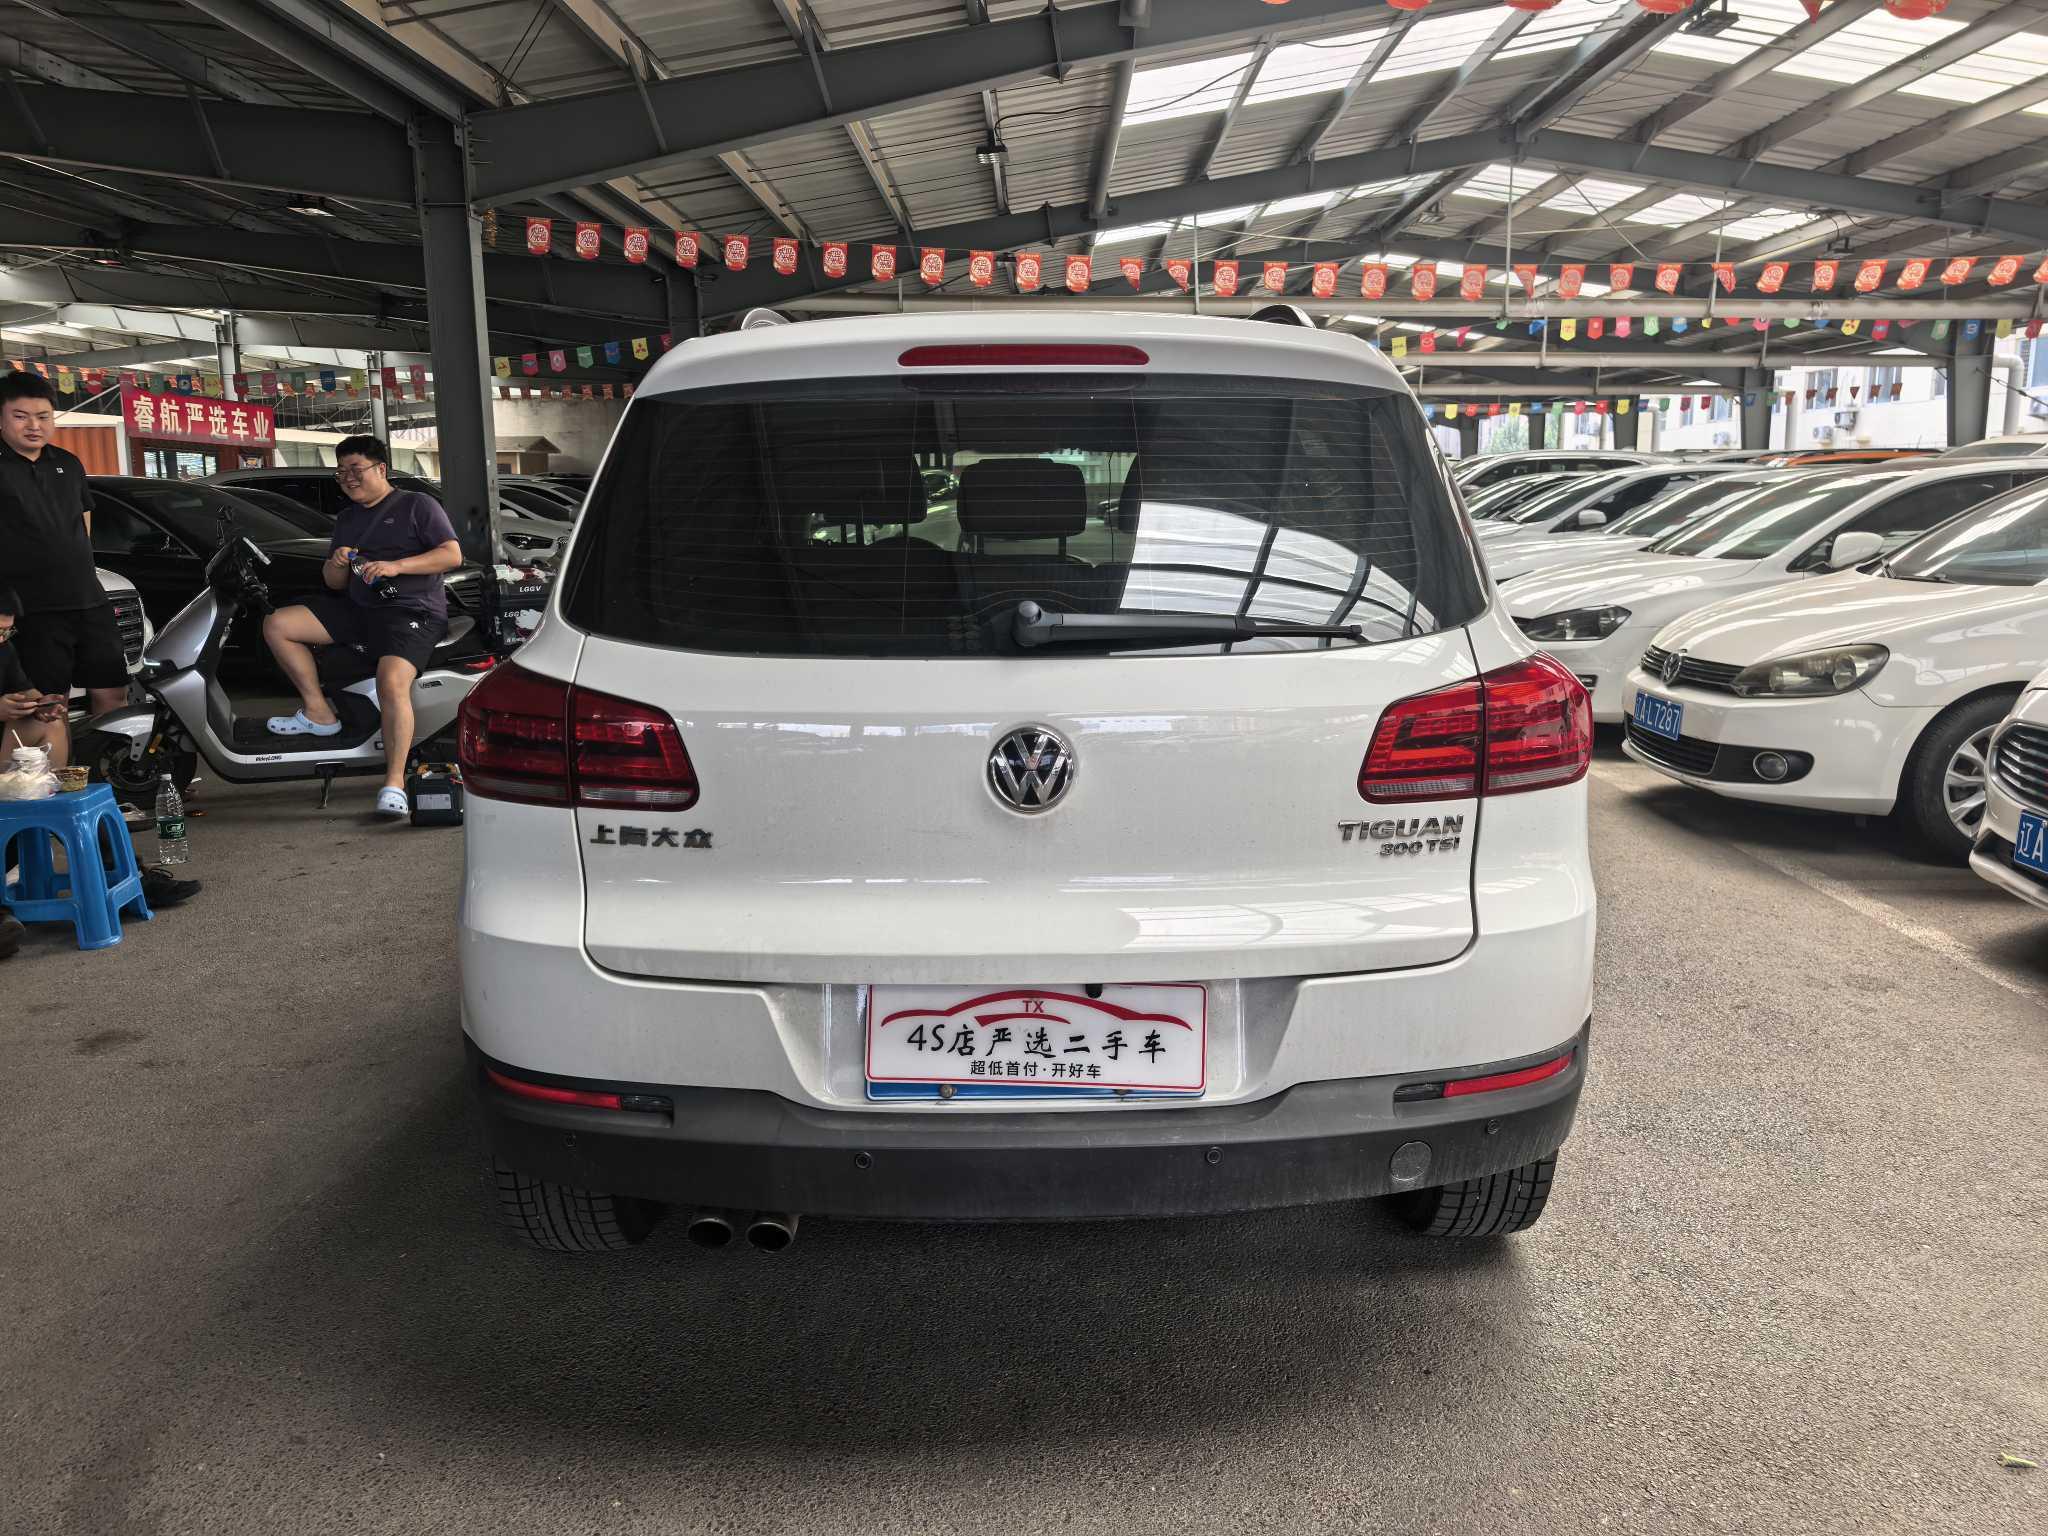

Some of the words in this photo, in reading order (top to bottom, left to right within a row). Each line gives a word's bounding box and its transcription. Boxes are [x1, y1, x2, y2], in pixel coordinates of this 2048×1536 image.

[132, 395, 271, 442] 睿航严选车业
[1338, 815, 1464, 841] TIGUAN
[1380, 842, 1423, 857] 300
[1427, 837, 1460, 852] TSI
[1022, 1000, 1044, 1014] TX
[906, 1023, 1166, 1064] 4S店严选二手车
[970, 1060, 1102, 1079] 超低首付·开好车
